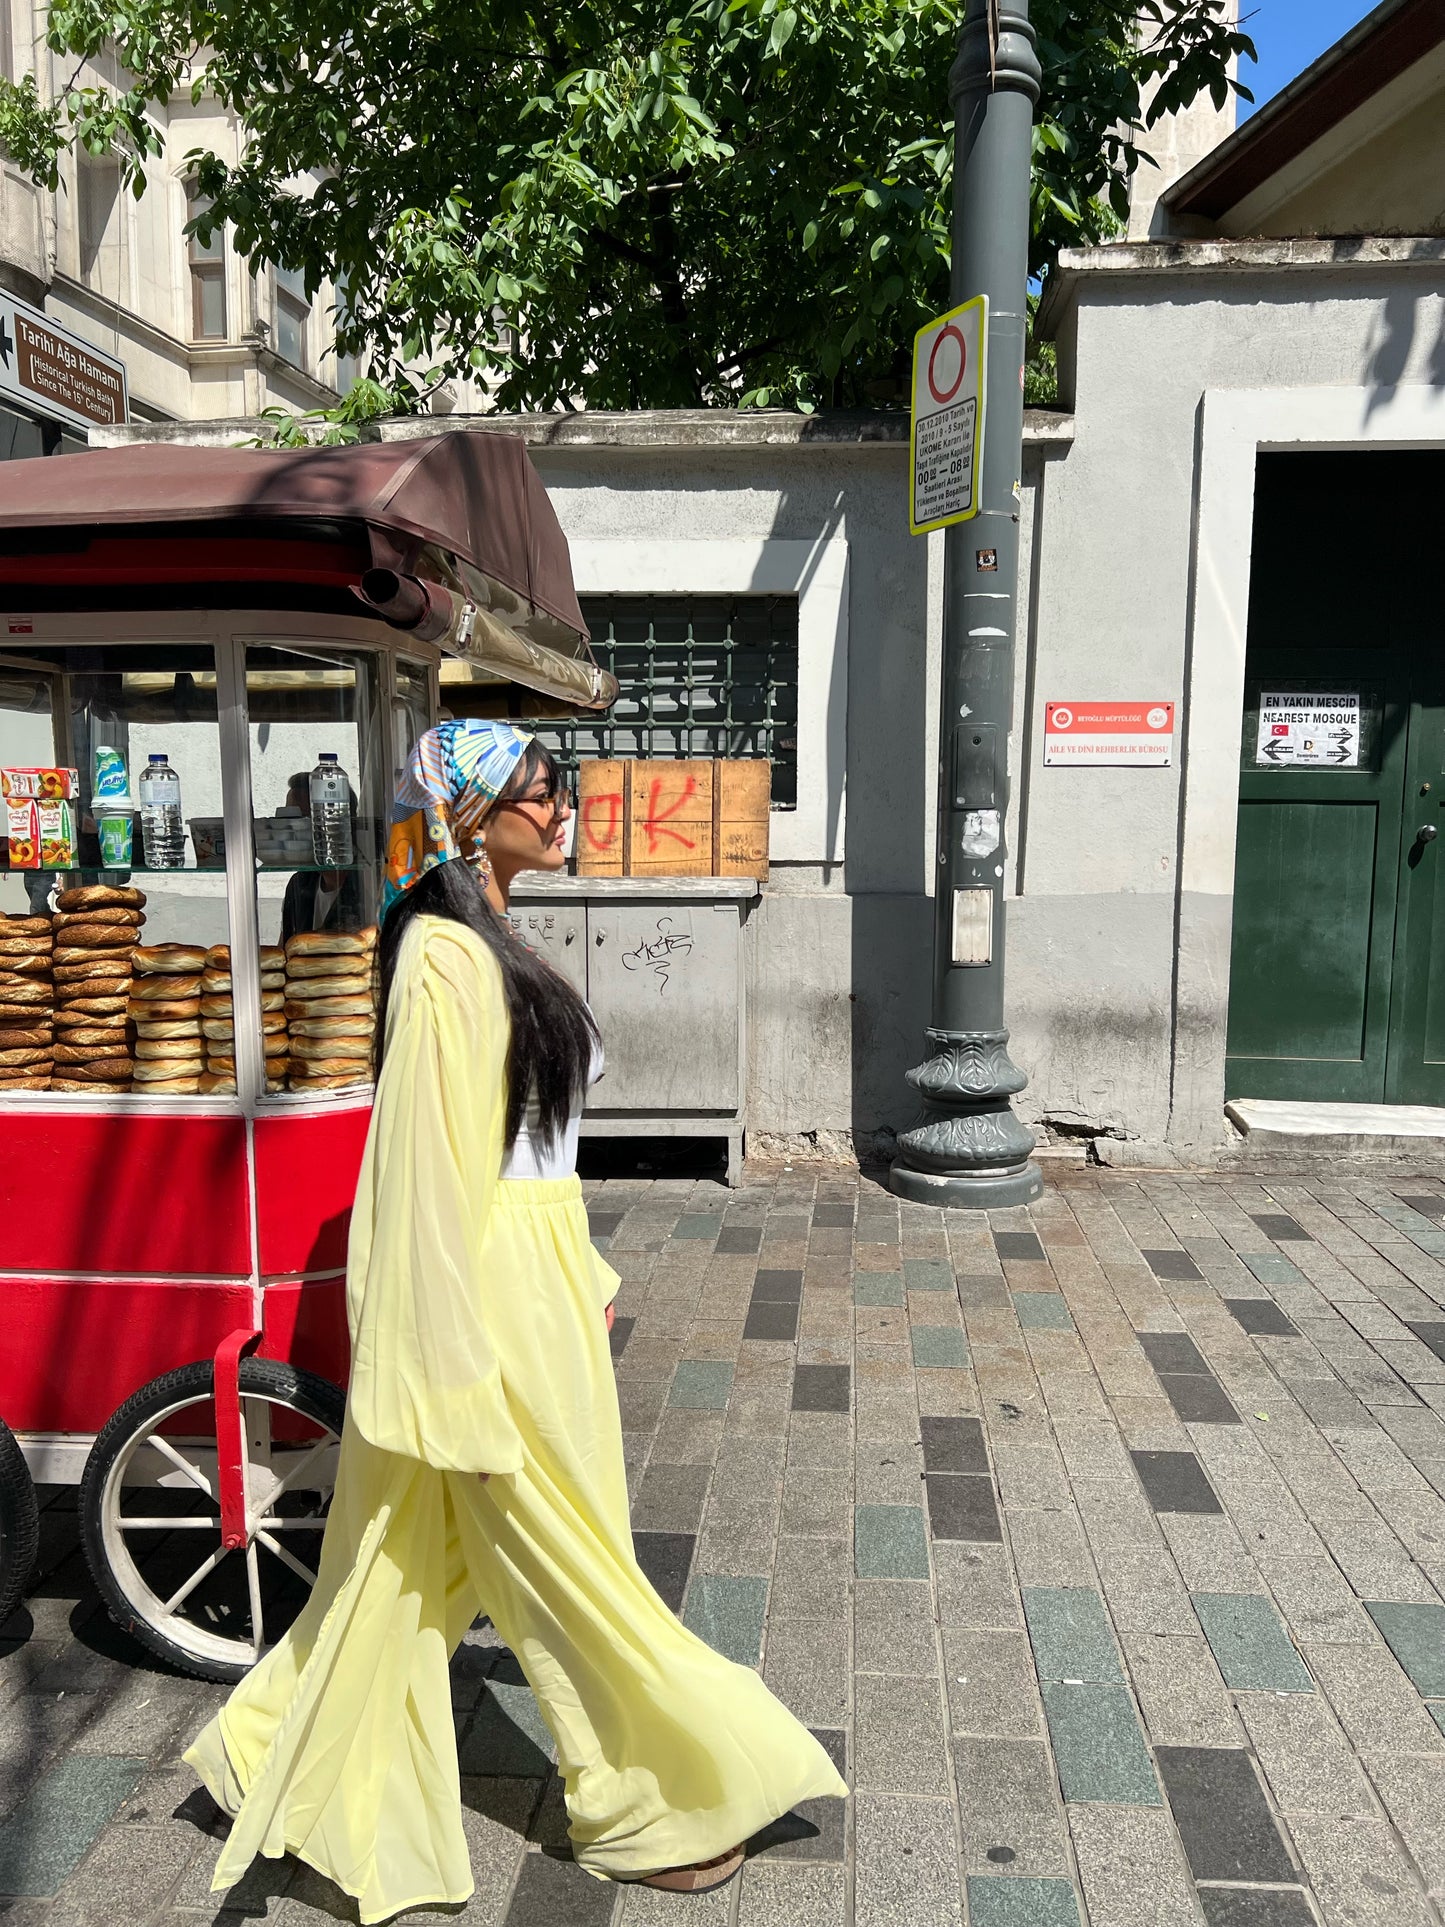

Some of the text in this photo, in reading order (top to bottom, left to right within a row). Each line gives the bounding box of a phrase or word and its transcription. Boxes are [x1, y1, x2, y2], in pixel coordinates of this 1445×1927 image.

[20, 321, 120, 392] Tarihi Ağa Hamamı
[36, 372, 57, 392] Since
[58, 383, 72, 399] The
[69, 374, 96, 397] Turkish
[96, 388, 112, 407] Bath
[918, 413, 949, 433] 30.12.2010
[967, 404, 974, 413] ve
[919, 440, 942, 457] UKOME
[1265, 694, 1357, 708] EN YAKIN MESCİD
[1263, 712, 1357, 724] NEAREST MOSQUE
[1048, 744, 1169, 754] AİLE VE DİNİ REHBERLİK BÜROSU
